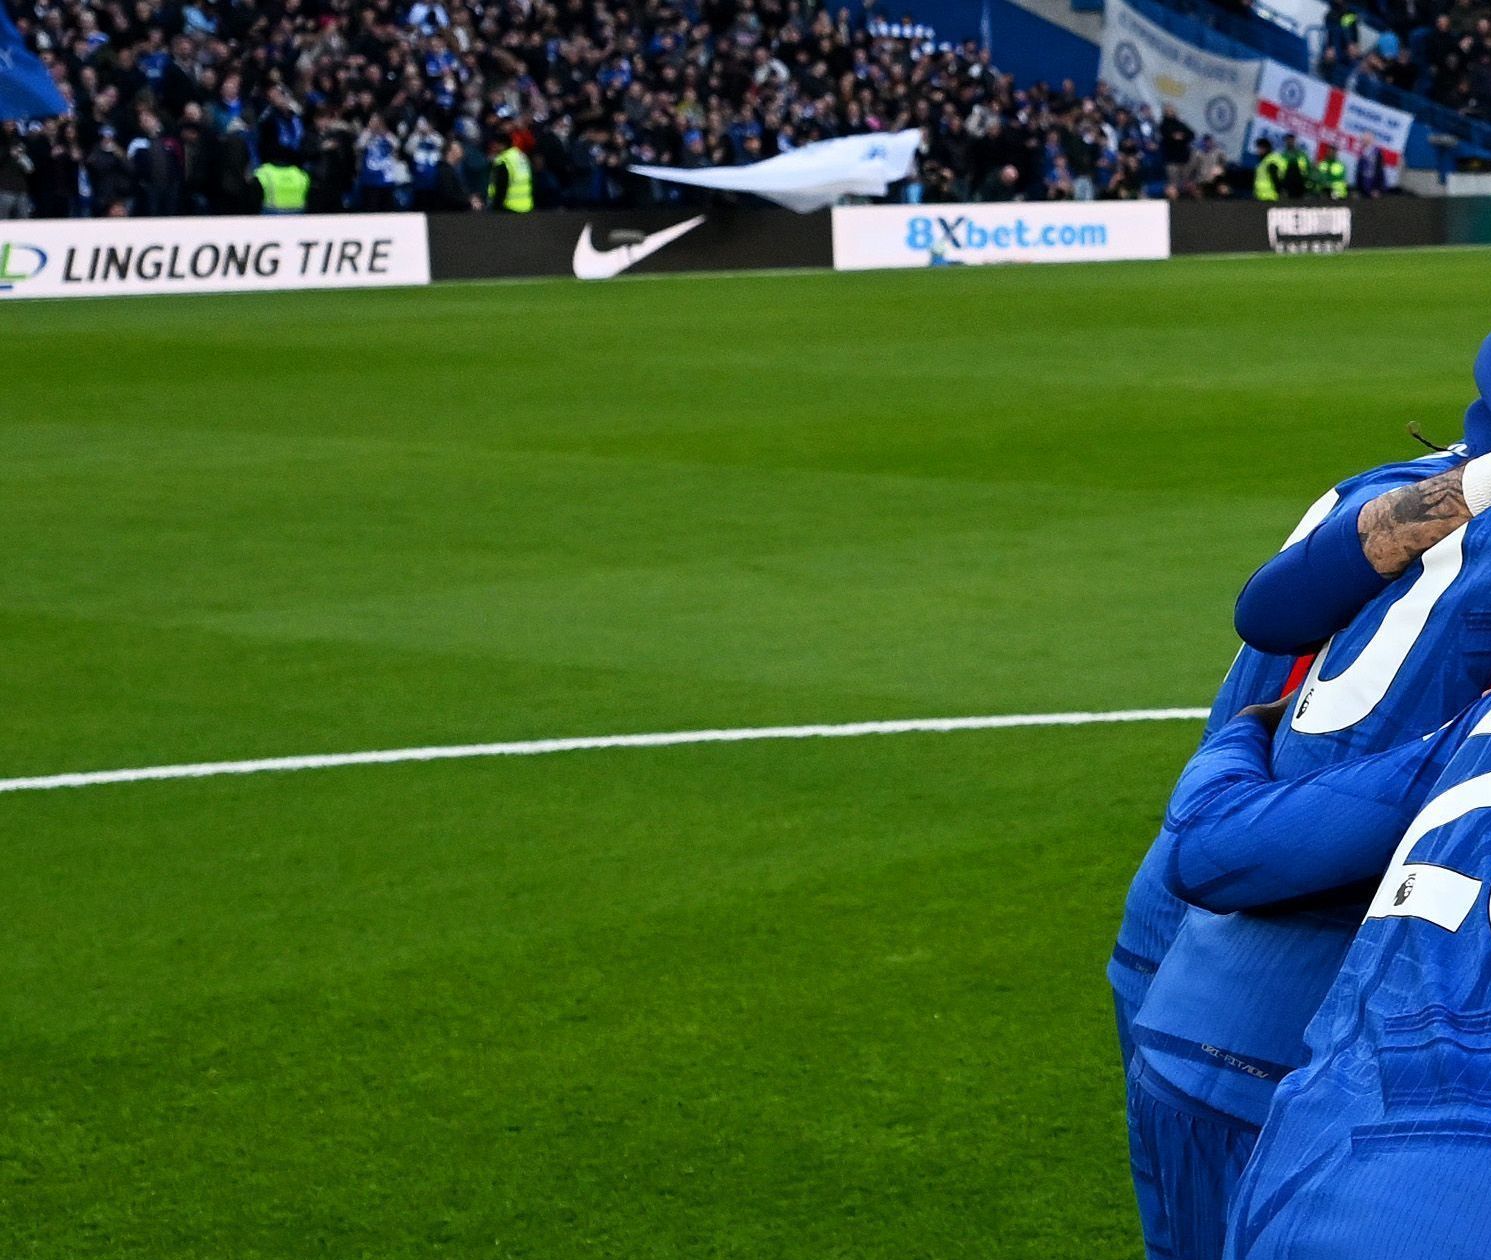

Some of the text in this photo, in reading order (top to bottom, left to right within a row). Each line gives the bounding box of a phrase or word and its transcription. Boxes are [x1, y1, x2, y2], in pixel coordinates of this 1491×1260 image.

[905, 215, 1107, 251] 8Xbet.com
[62, 239, 393, 283] LINGLONG TIRE
